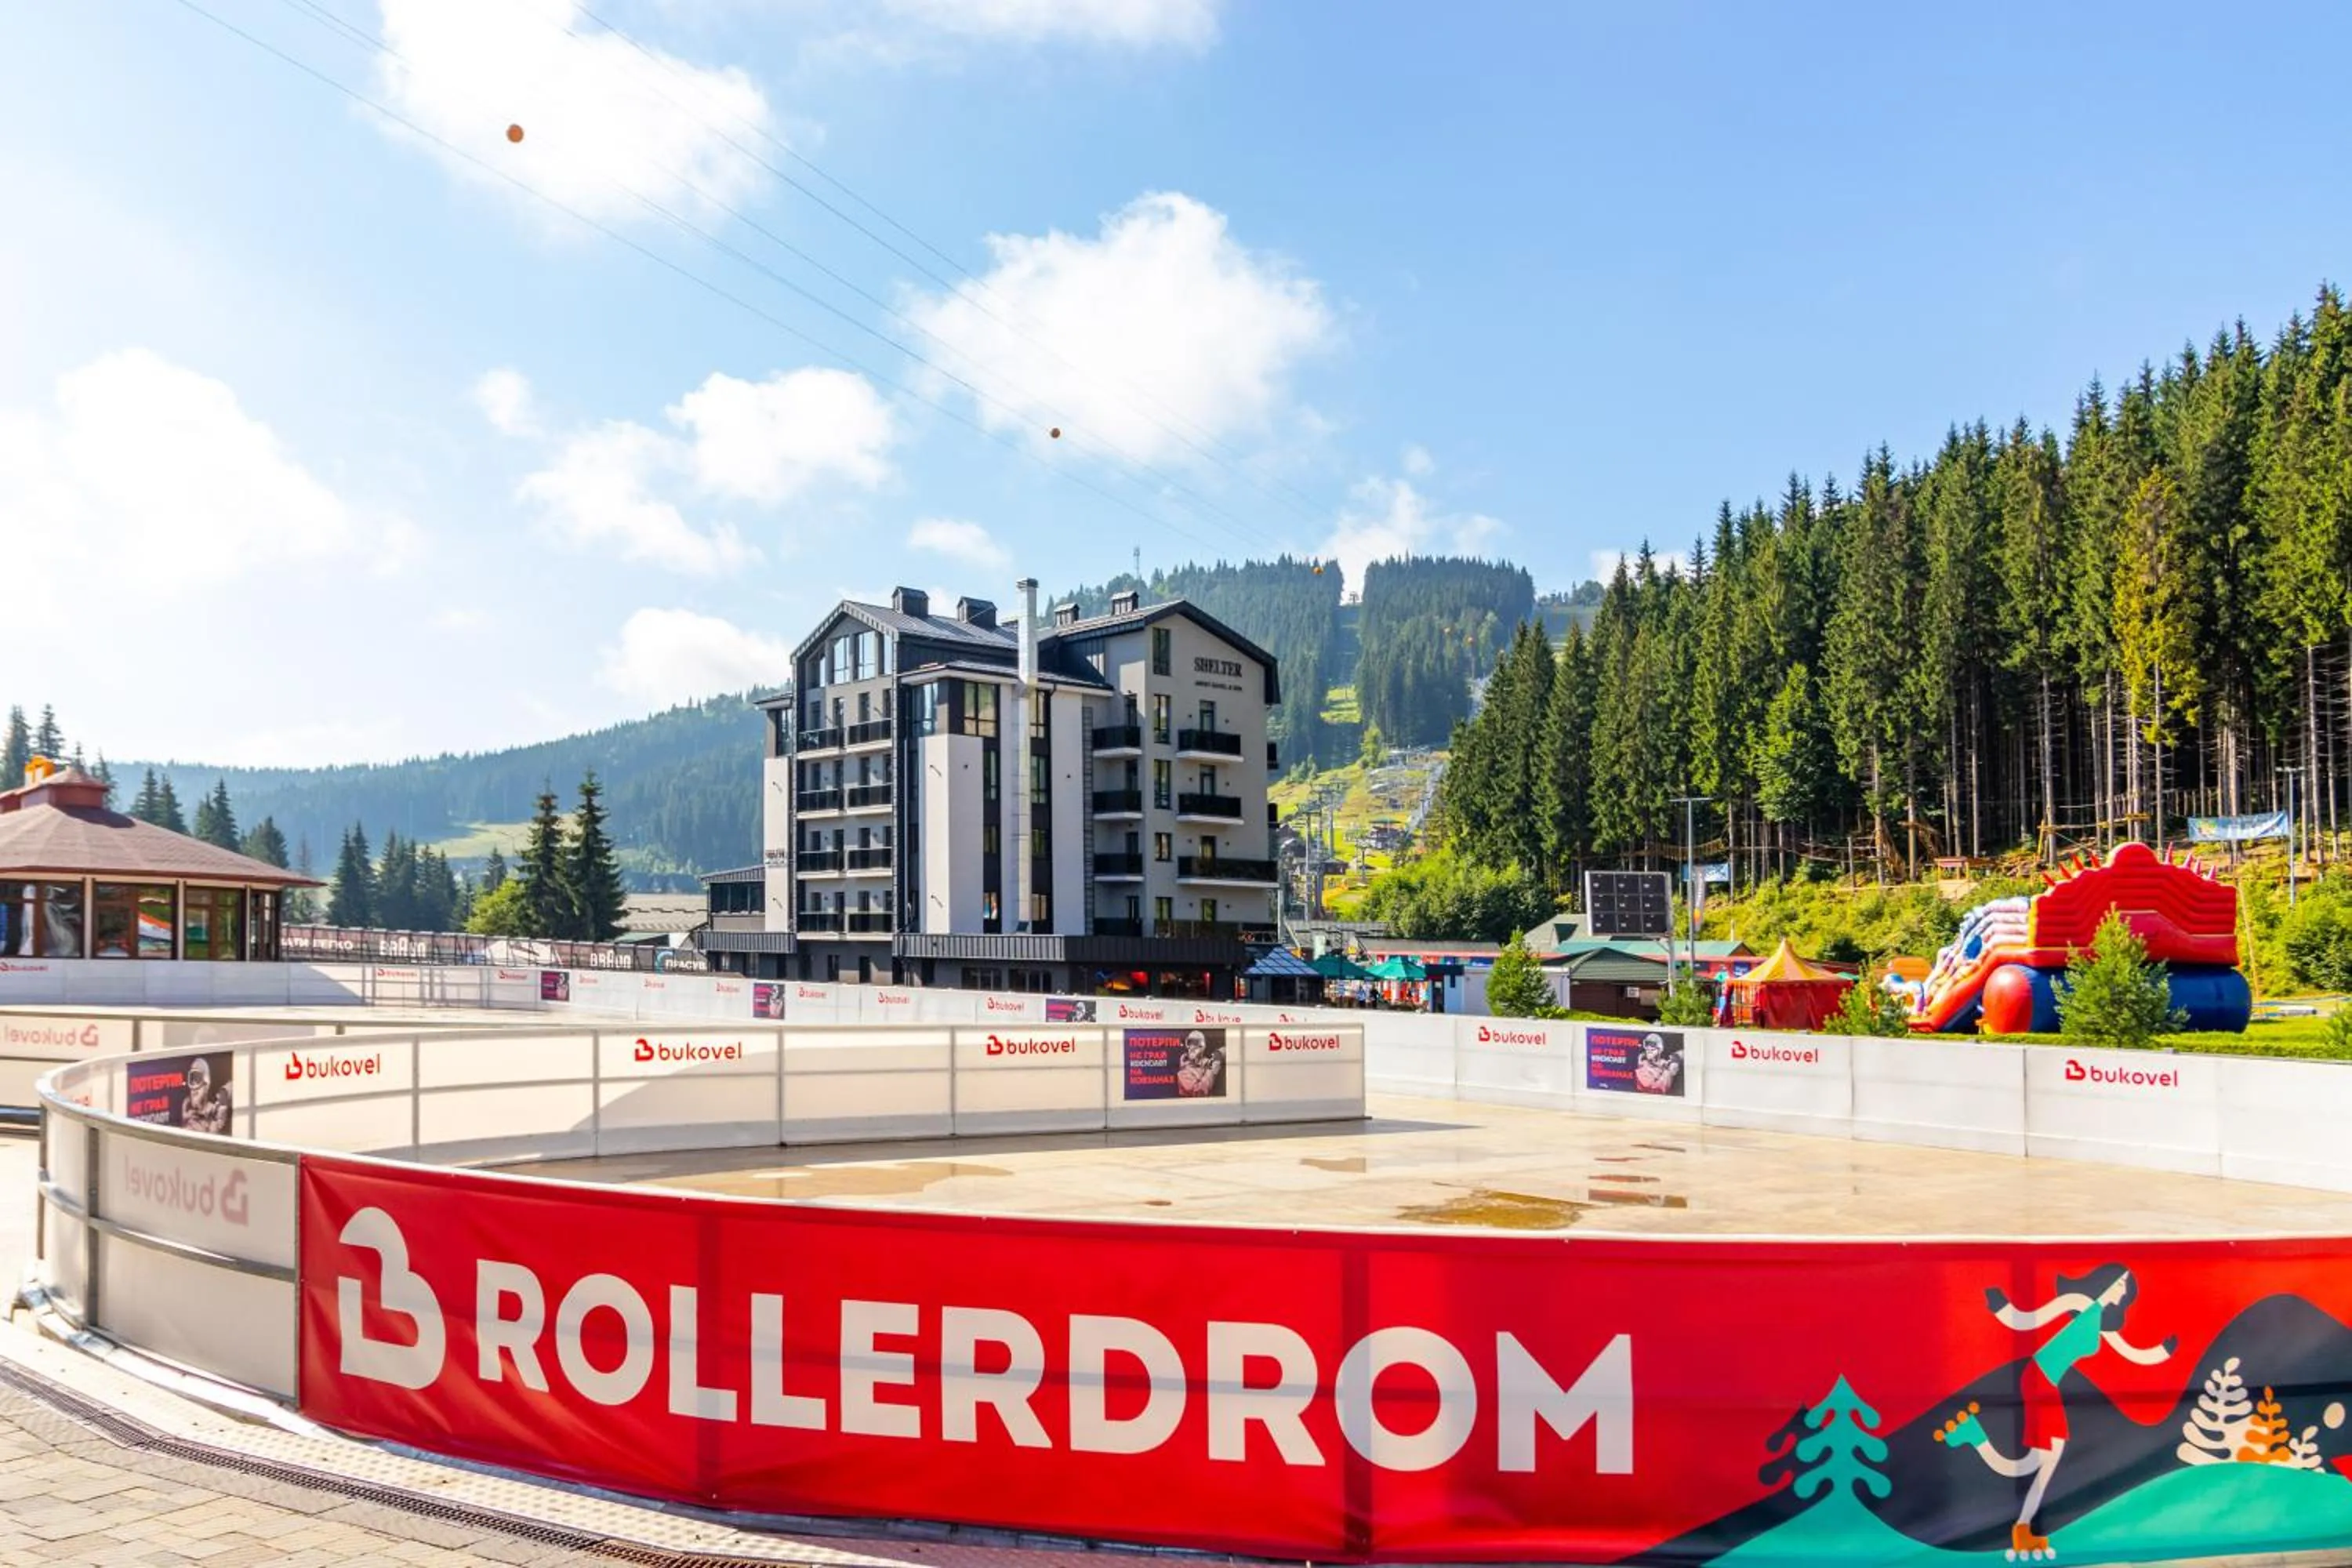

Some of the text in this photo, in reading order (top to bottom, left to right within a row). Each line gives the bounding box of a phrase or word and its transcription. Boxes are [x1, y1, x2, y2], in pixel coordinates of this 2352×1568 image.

[1194, 657, 1242, 677] SHELTER
[590, 949, 631, 969] BRAUN
[1007, 1037, 1076, 1054] bukovel
[1284, 1033, 1340, 1051] bukovel
[1492, 1031, 1547, 1046] bukovel
[658, 1041, 742, 1062] bukovel
[1749, 1044, 1820, 1063] bukovel
[307, 1054, 381, 1079] bukovel
[2089, 1065, 2179, 1087] bukovel
[477, 1258, 1633, 1474] ROLLERDROM
